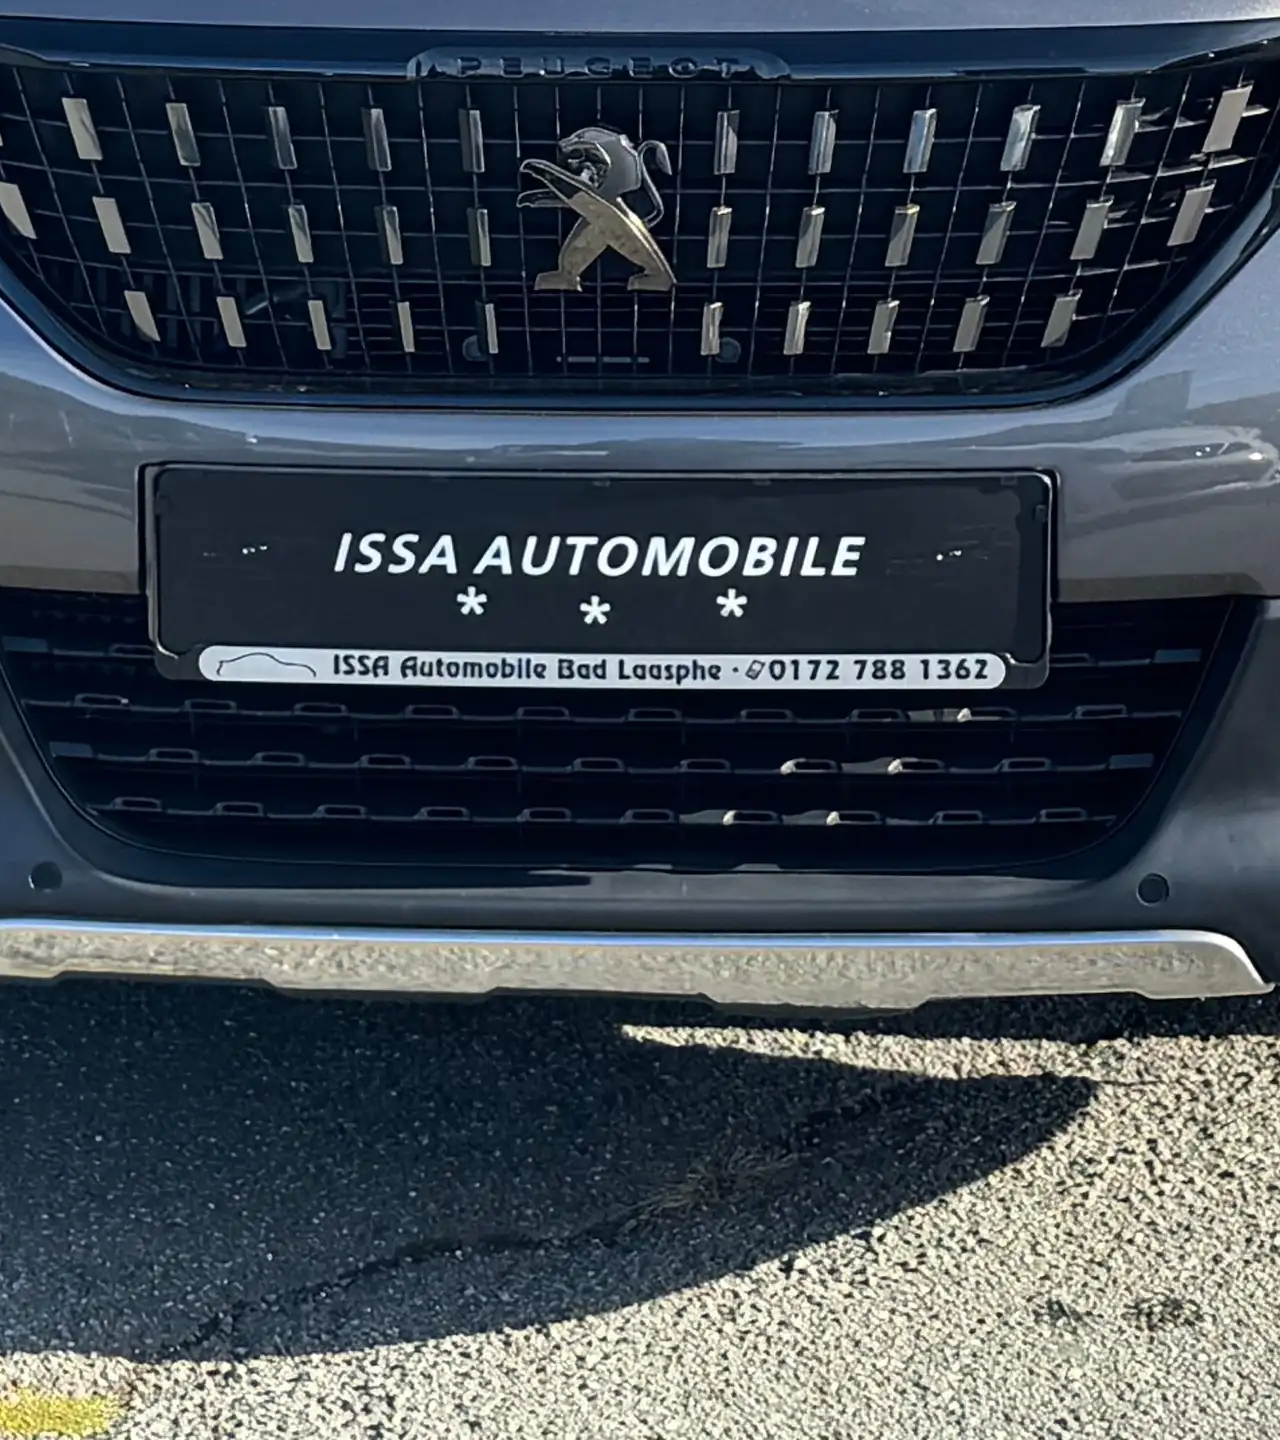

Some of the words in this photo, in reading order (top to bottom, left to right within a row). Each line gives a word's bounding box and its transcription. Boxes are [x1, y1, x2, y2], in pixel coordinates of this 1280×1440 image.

[456, 56, 751, 78] PEUGEOT
[334, 532, 458, 574] ISSA
[472, 535, 866, 577] AUTOMOBILE
[333, 654, 390, 678] ISSA
[400, 656, 547, 679] Automobile
[558, 658, 607, 679] Bad
[618, 658, 721, 685] Laasphe
[769, 659, 840, 680] 0172
[853, 659, 906, 680] 788
[919, 659, 988, 680] 1362
